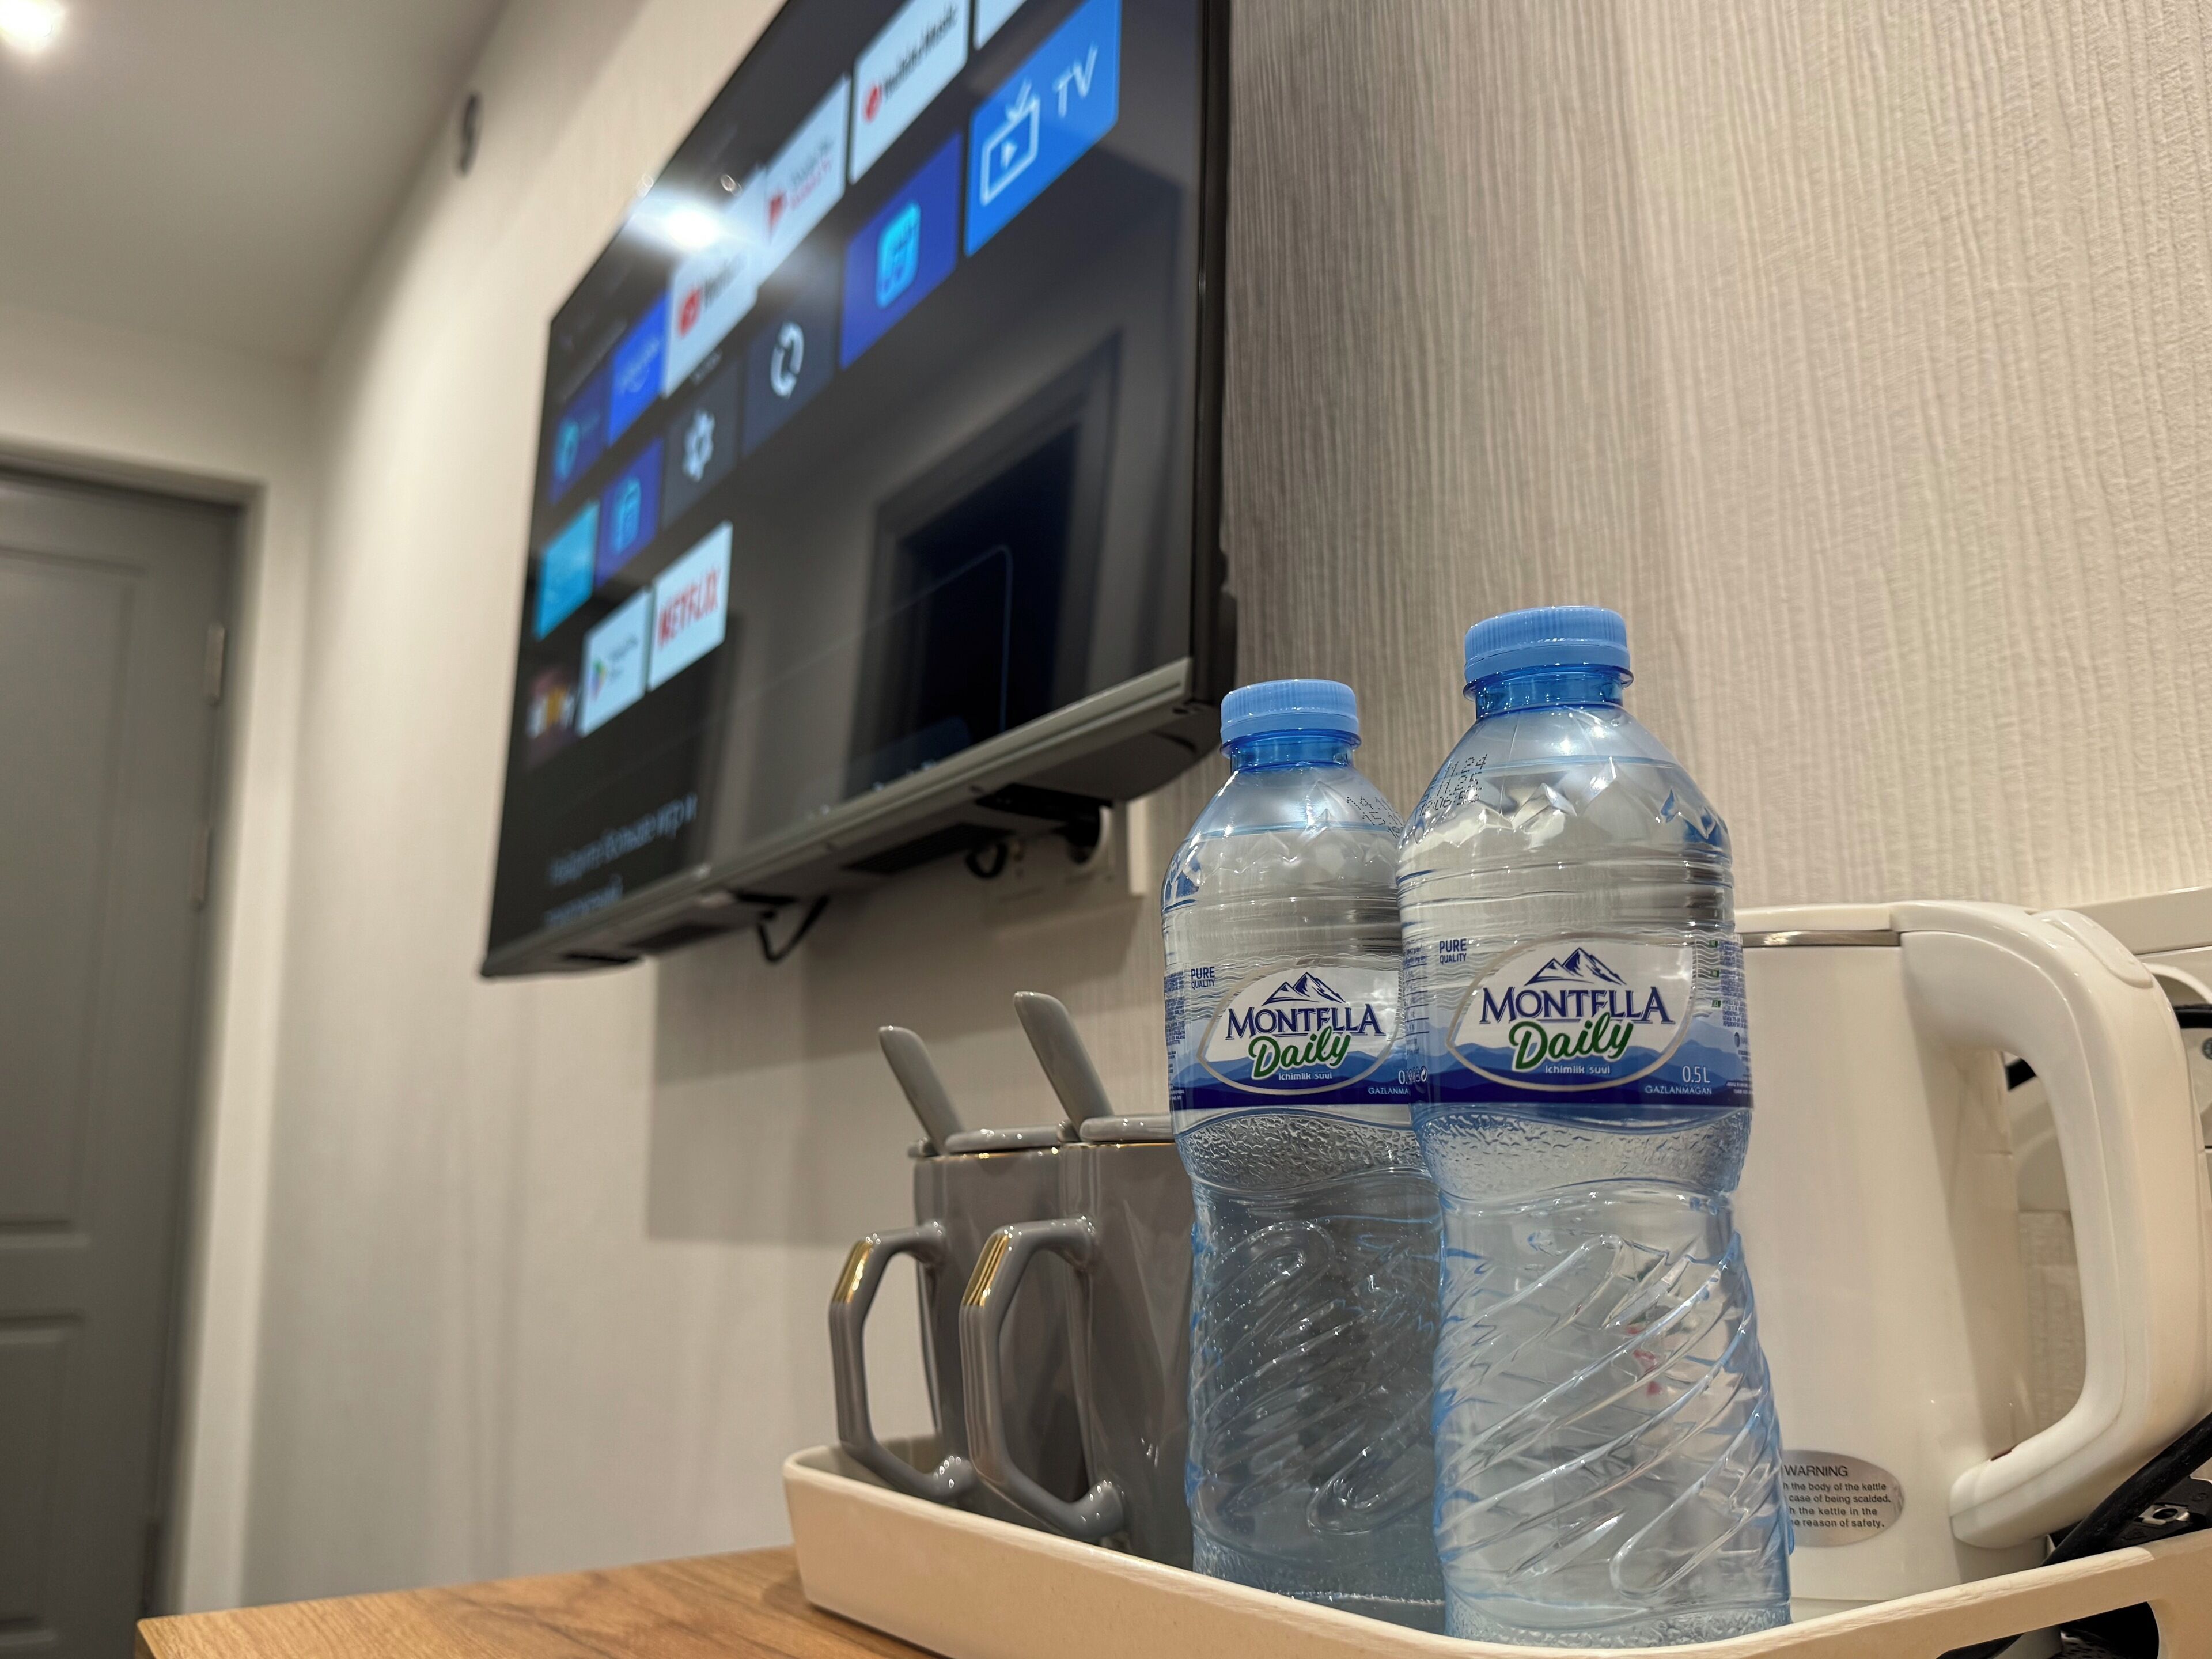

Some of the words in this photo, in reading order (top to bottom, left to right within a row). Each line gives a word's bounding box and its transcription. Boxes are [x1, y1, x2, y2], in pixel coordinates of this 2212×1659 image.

[1052, 41, 1099, 119] TV
[658, 569, 719, 646] NETFLIX
[1440, 938, 1467, 953] PURE
[1440, 953, 1467, 965] QUALITY
[1191, 967, 1215, 979] PURE
[1191, 979, 1215, 990] QUALITY
[1479, 986, 1676, 1024] MONTELLA
[1225, 1004, 1386, 1040] MONTELLA
[1508, 1012, 1634, 1070] Daily
[1248, 1026, 1351, 1078] Daily
[1682, 1066, 1710, 1083] 0.5L
[1645, 1085, 1713, 1095] GAZLANMAGAN
[1784, 1465, 1848, 1476] WARNING
[1791, 1482, 1806, 1491] the
[1808, 1482, 1830, 1492] body
[1834, 1483, 1842, 1491] of
[1845, 1483, 1859, 1491] the
[1862, 1482, 1887, 1491] kettle
[1813, 1494, 1822, 1502] of
[1825, 1494, 1850, 1504] being
[1853, 1494, 1891, 1503] scalded.
[1798, 1506, 1815, 1514] the
[1818, 1506, 1846, 1515] kettle
[1850, 1507, 1859, 1515] in
[1862, 1507, 1878, 1515] the
[1839, 1518, 1849, 1527] of
[1851, 1518, 1885, 1529] safety.
